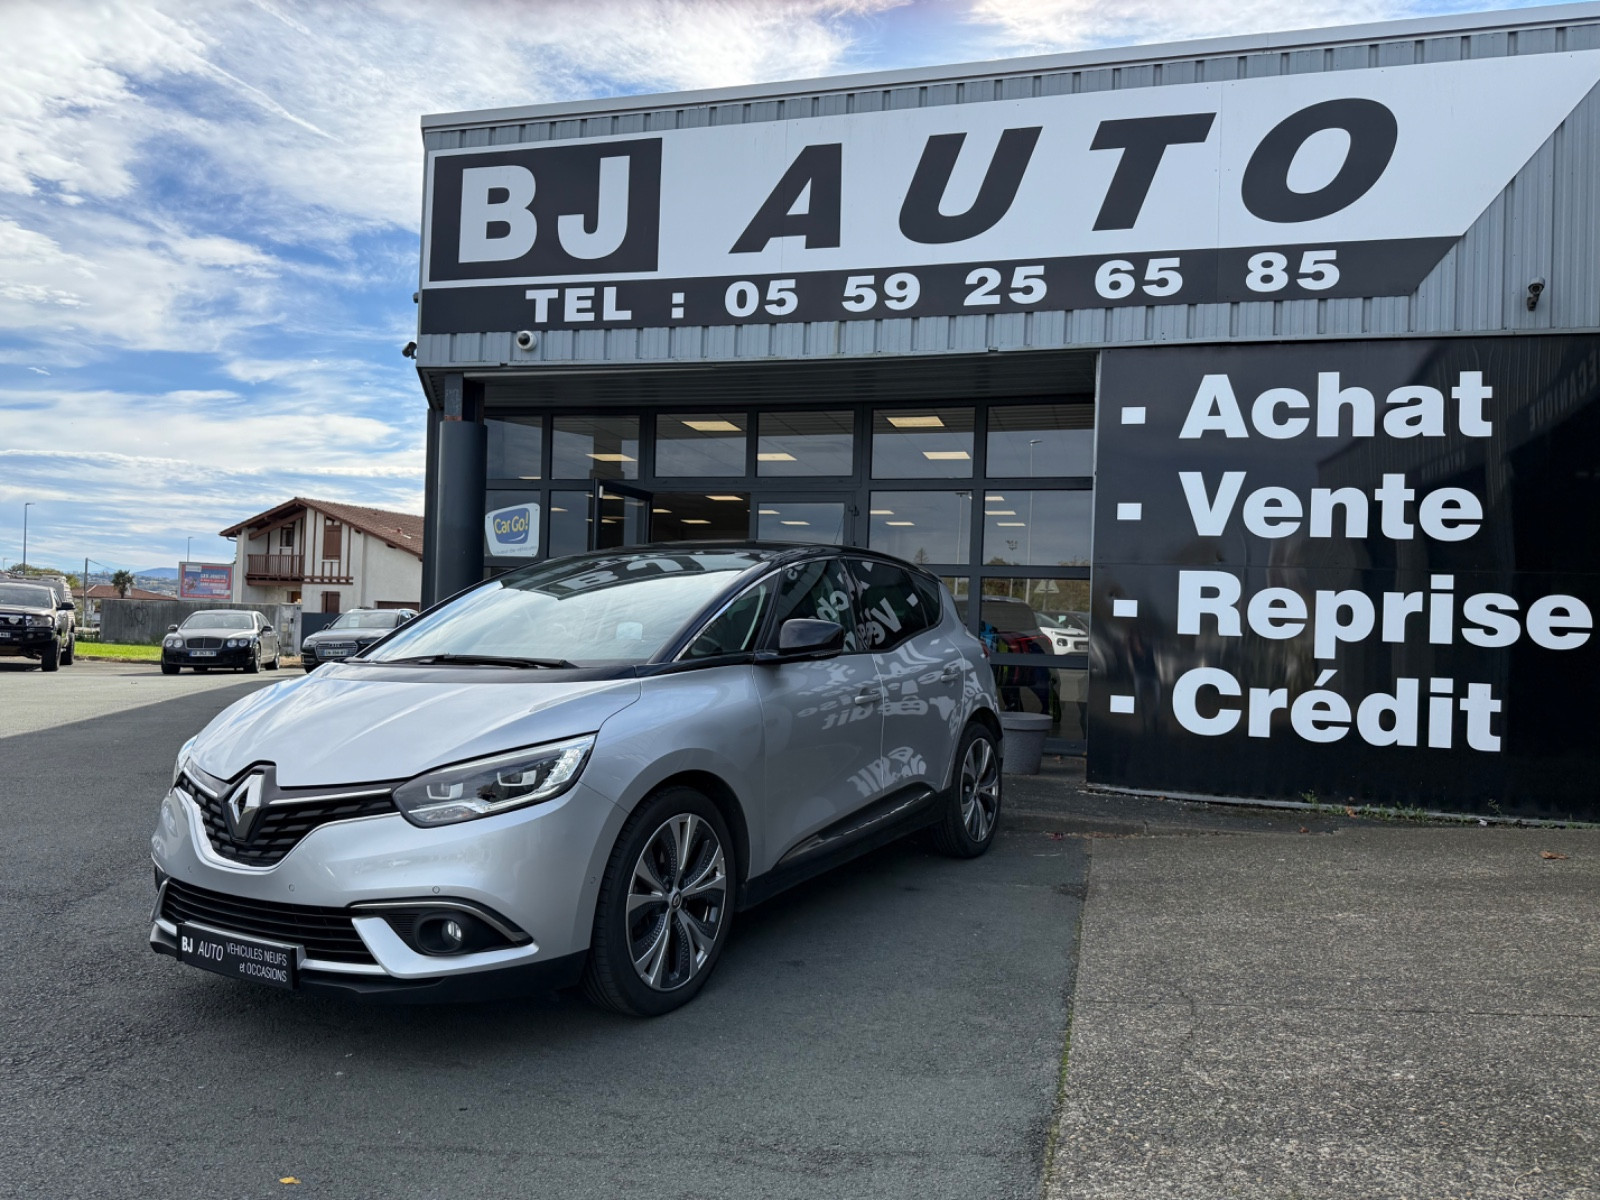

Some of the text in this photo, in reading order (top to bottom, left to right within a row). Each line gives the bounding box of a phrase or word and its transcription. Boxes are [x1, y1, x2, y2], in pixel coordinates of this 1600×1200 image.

[459, 97, 1398, 263] BJ AUTO
[526, 287, 632, 323] TEL
[725, 279, 799, 317] 05
[842, 273, 921, 313] 59
[964, 266, 1048, 306] 25
[1095, 257, 1183, 299] 65
[1246, 249, 1340, 292] 85
[1179, 371, 1493, 440] Achat
[1178, 472, 1483, 542] Vente
[1178, 570, 1593, 660] Reprise
[1172, 664, 1502, 752] Crédit
[181, 936, 224, 961] BJ AUTO
[239, 962, 287, 982] et OCCASIONS
[264, 950, 288, 966] NEUFS
